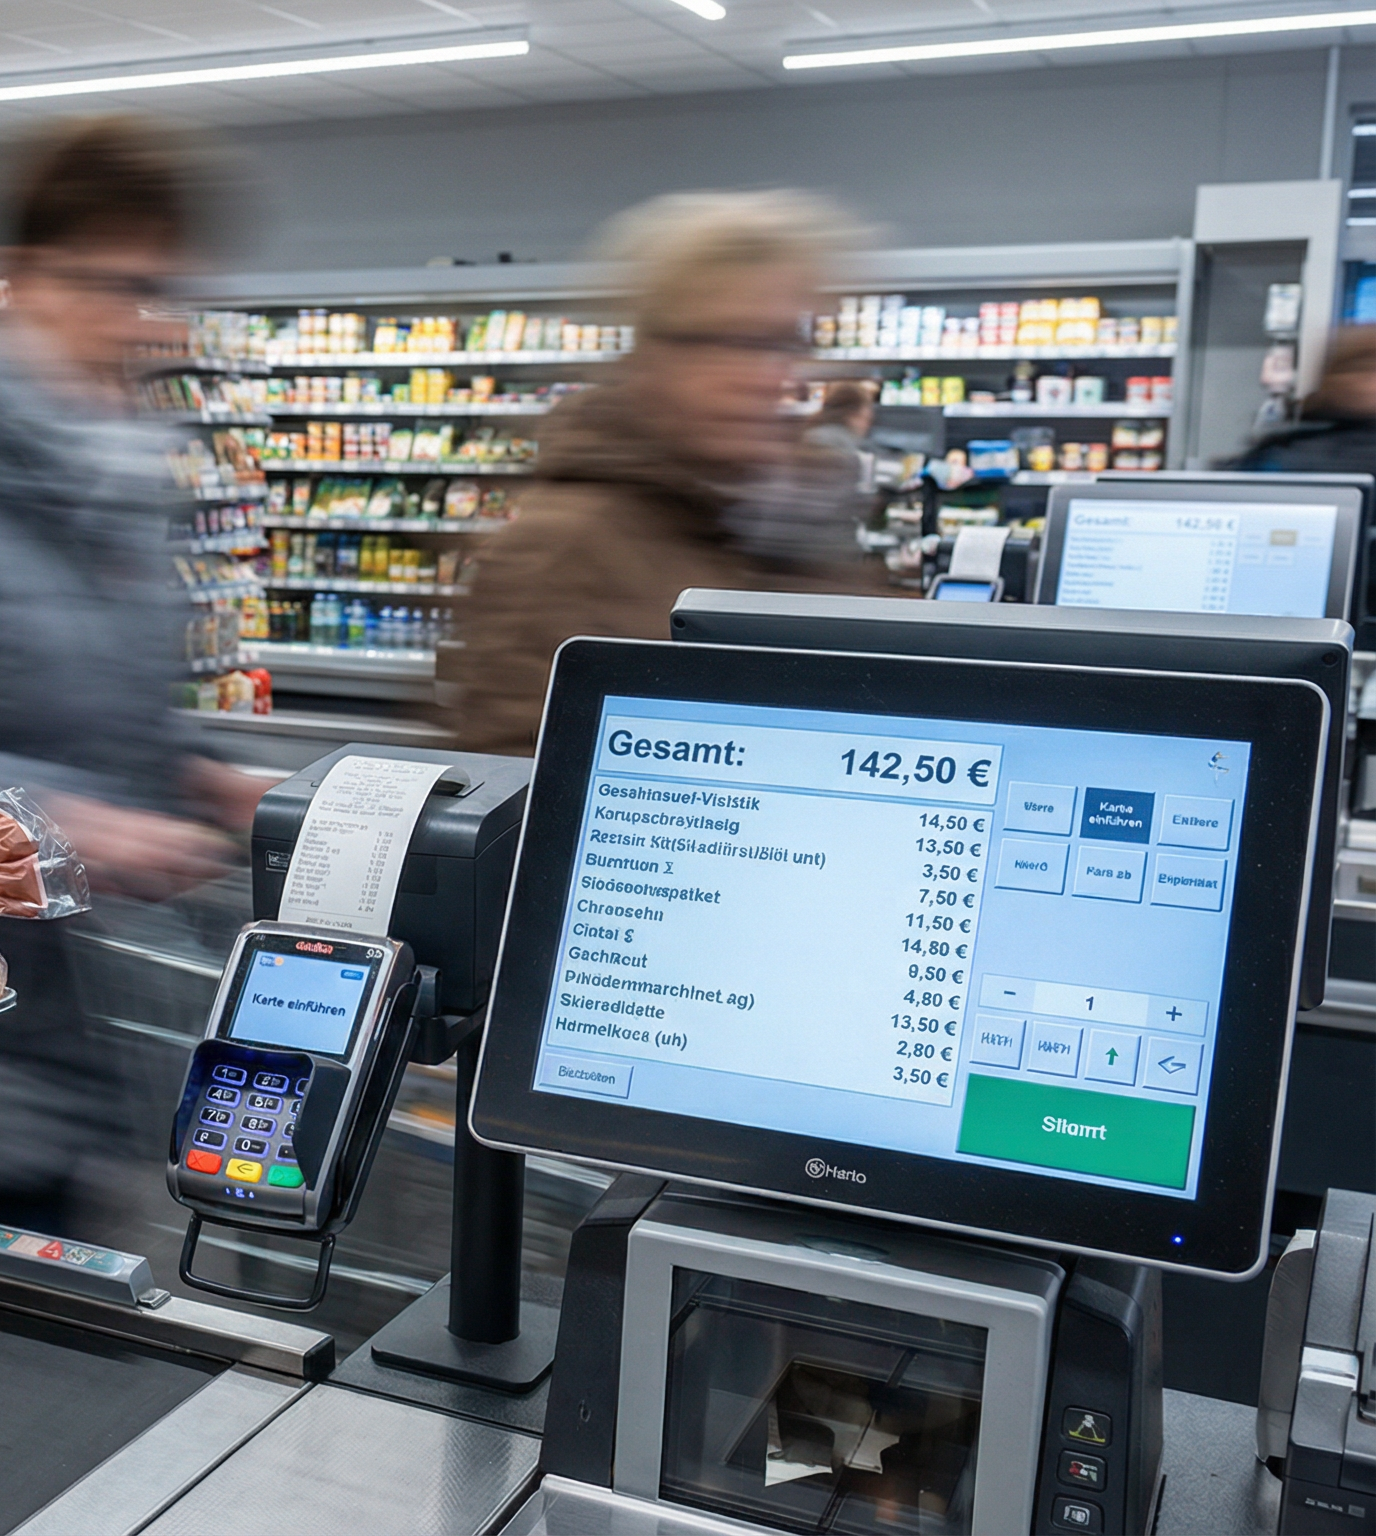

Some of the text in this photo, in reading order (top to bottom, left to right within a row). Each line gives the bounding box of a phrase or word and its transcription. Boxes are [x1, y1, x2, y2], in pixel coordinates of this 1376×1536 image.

[608, 729, 992, 787] Gesamt: 142,50 €
[919, 813, 967, 831] 14,50
[973, 818, 985, 832] €
[915, 838, 964, 856] 13,50
[969, 843, 982, 857] €
[922, 864, 961, 881] 3,50
[966, 868, 978, 883] €
[919, 889, 957, 907] 7,50
[962, 893, 975, 908] €
[905, 913, 954, 932] 11,50
[959, 919, 971, 934] €
[901, 938, 950, 957] 14,80
[955, 944, 968, 959] €
[952, 970, 964, 984] €
[903, 989, 943, 1008] 4,80
[948, 996, 961, 1010] €
[1085, 996, 1094, 1011] 1
[891, 1014, 939, 1033] 13,50
[944, 1021, 957, 1036] €
[896, 1040, 935, 1059] 2,80
[940, 1047, 953, 1061] €
[893, 1066, 931, 1085] 3,50
[936, 1072, 949, 1088] €
